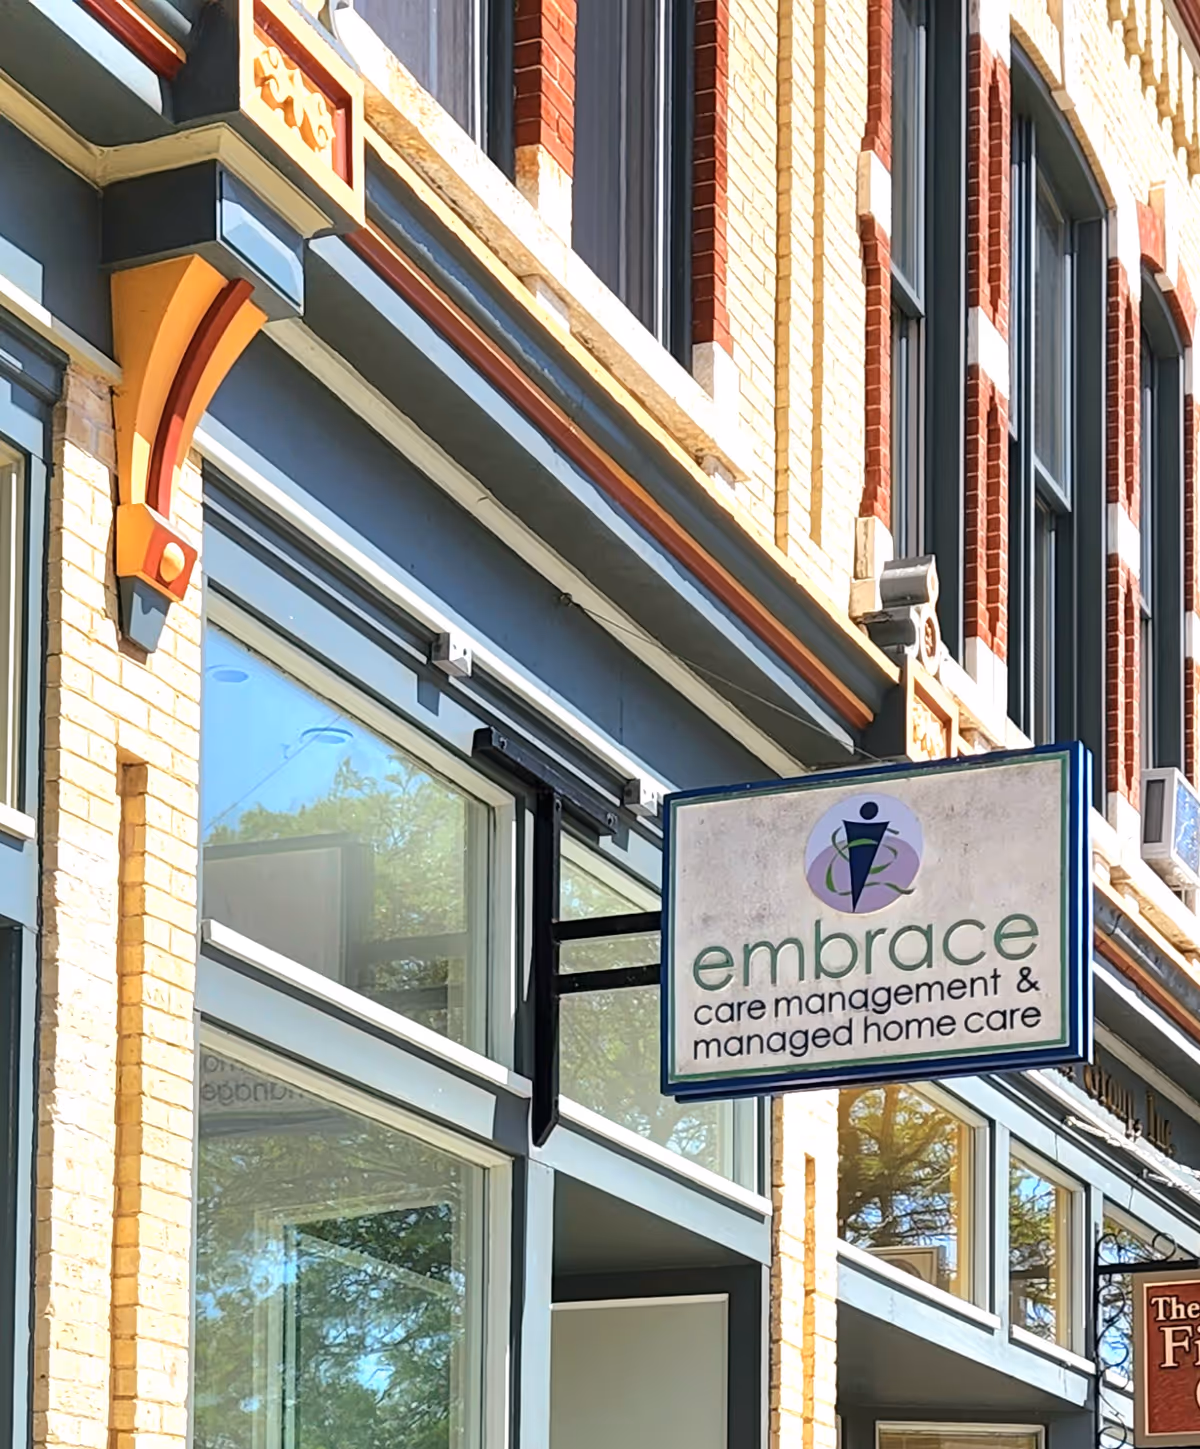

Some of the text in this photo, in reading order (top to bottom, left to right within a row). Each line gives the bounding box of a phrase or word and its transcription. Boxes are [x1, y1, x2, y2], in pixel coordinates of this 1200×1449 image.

[693, 913, 1039, 991] embrace
[694, 966, 1041, 1025] care management &
[693, 1006, 1042, 1060] managed home care
[1150, 1296, 1200, 1321] The
